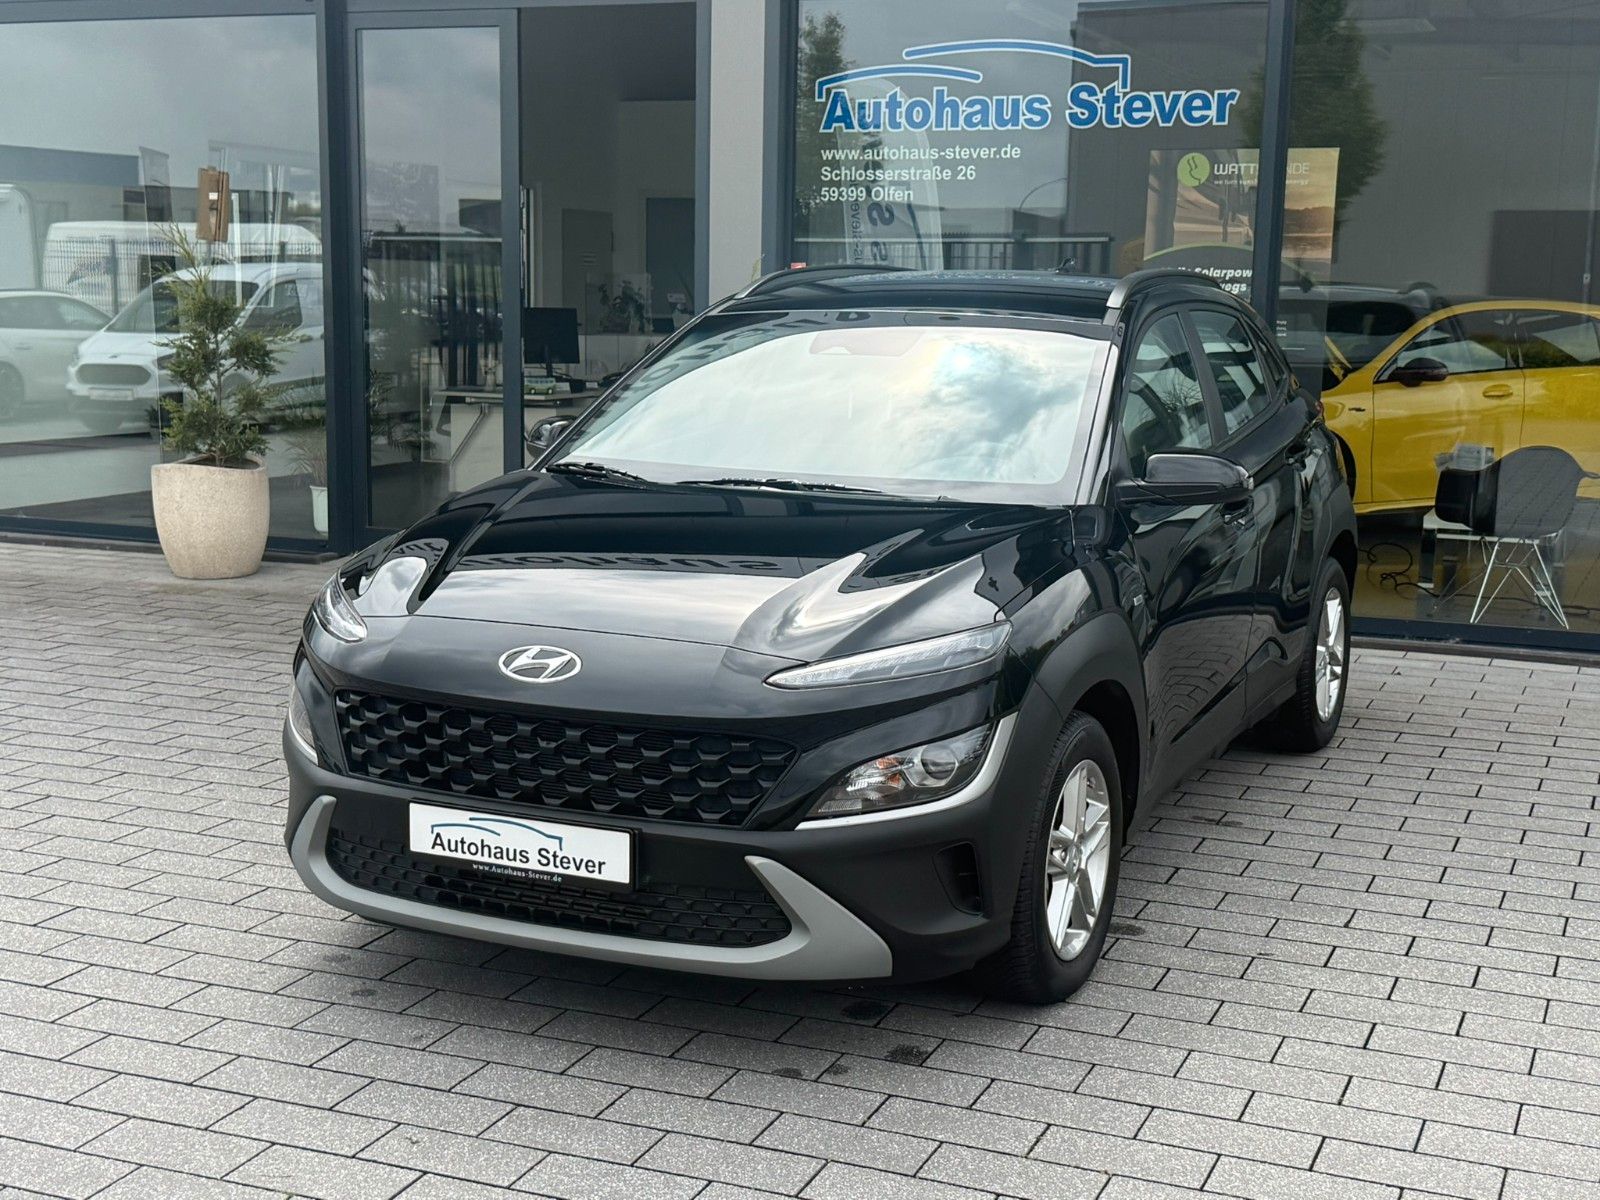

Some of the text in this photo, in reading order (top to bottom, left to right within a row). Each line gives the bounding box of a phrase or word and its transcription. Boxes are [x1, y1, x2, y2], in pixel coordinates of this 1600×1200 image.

[820, 82, 1240, 133] Autohaus Stever
[821, 143, 1021, 161] www.autohaus-stever.de
[820, 165, 976, 182] Schlosserstraße 26
[820, 186, 914, 202] 59399 Olfen
[431, 832, 606, 875] Autohaus Stever
[472, 863, 562, 882] www.Autohaus-Stever.de
